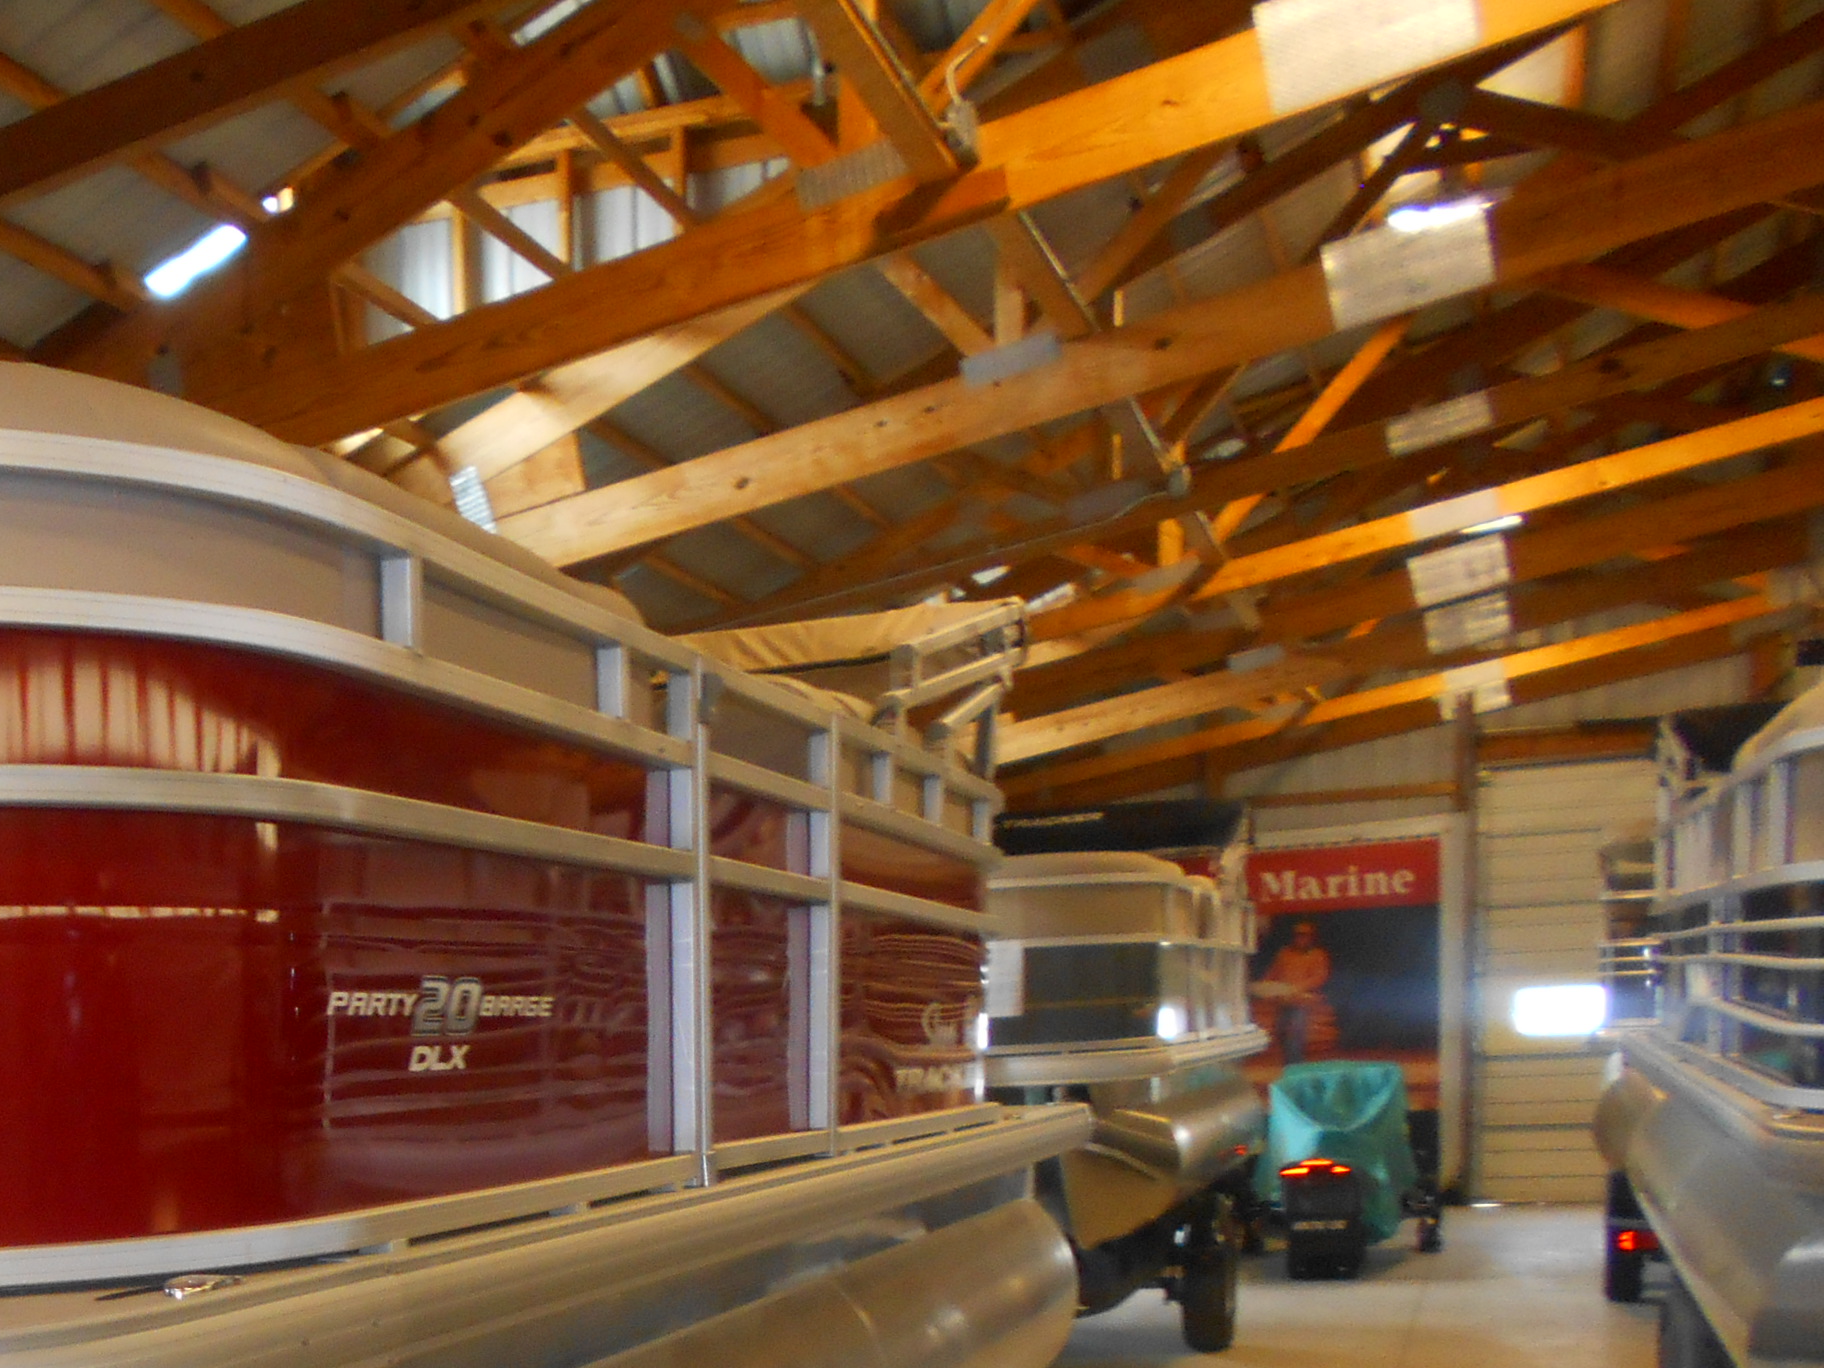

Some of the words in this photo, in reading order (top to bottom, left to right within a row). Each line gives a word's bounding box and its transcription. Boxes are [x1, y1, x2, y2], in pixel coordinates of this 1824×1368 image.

[1259, 865, 1416, 902] Marine
[327, 991, 418, 1016] PARTY
[411, 975, 482, 1036] 20
[479, 995, 555, 1017] BARGE
[408, 1044, 470, 1072] DLX
